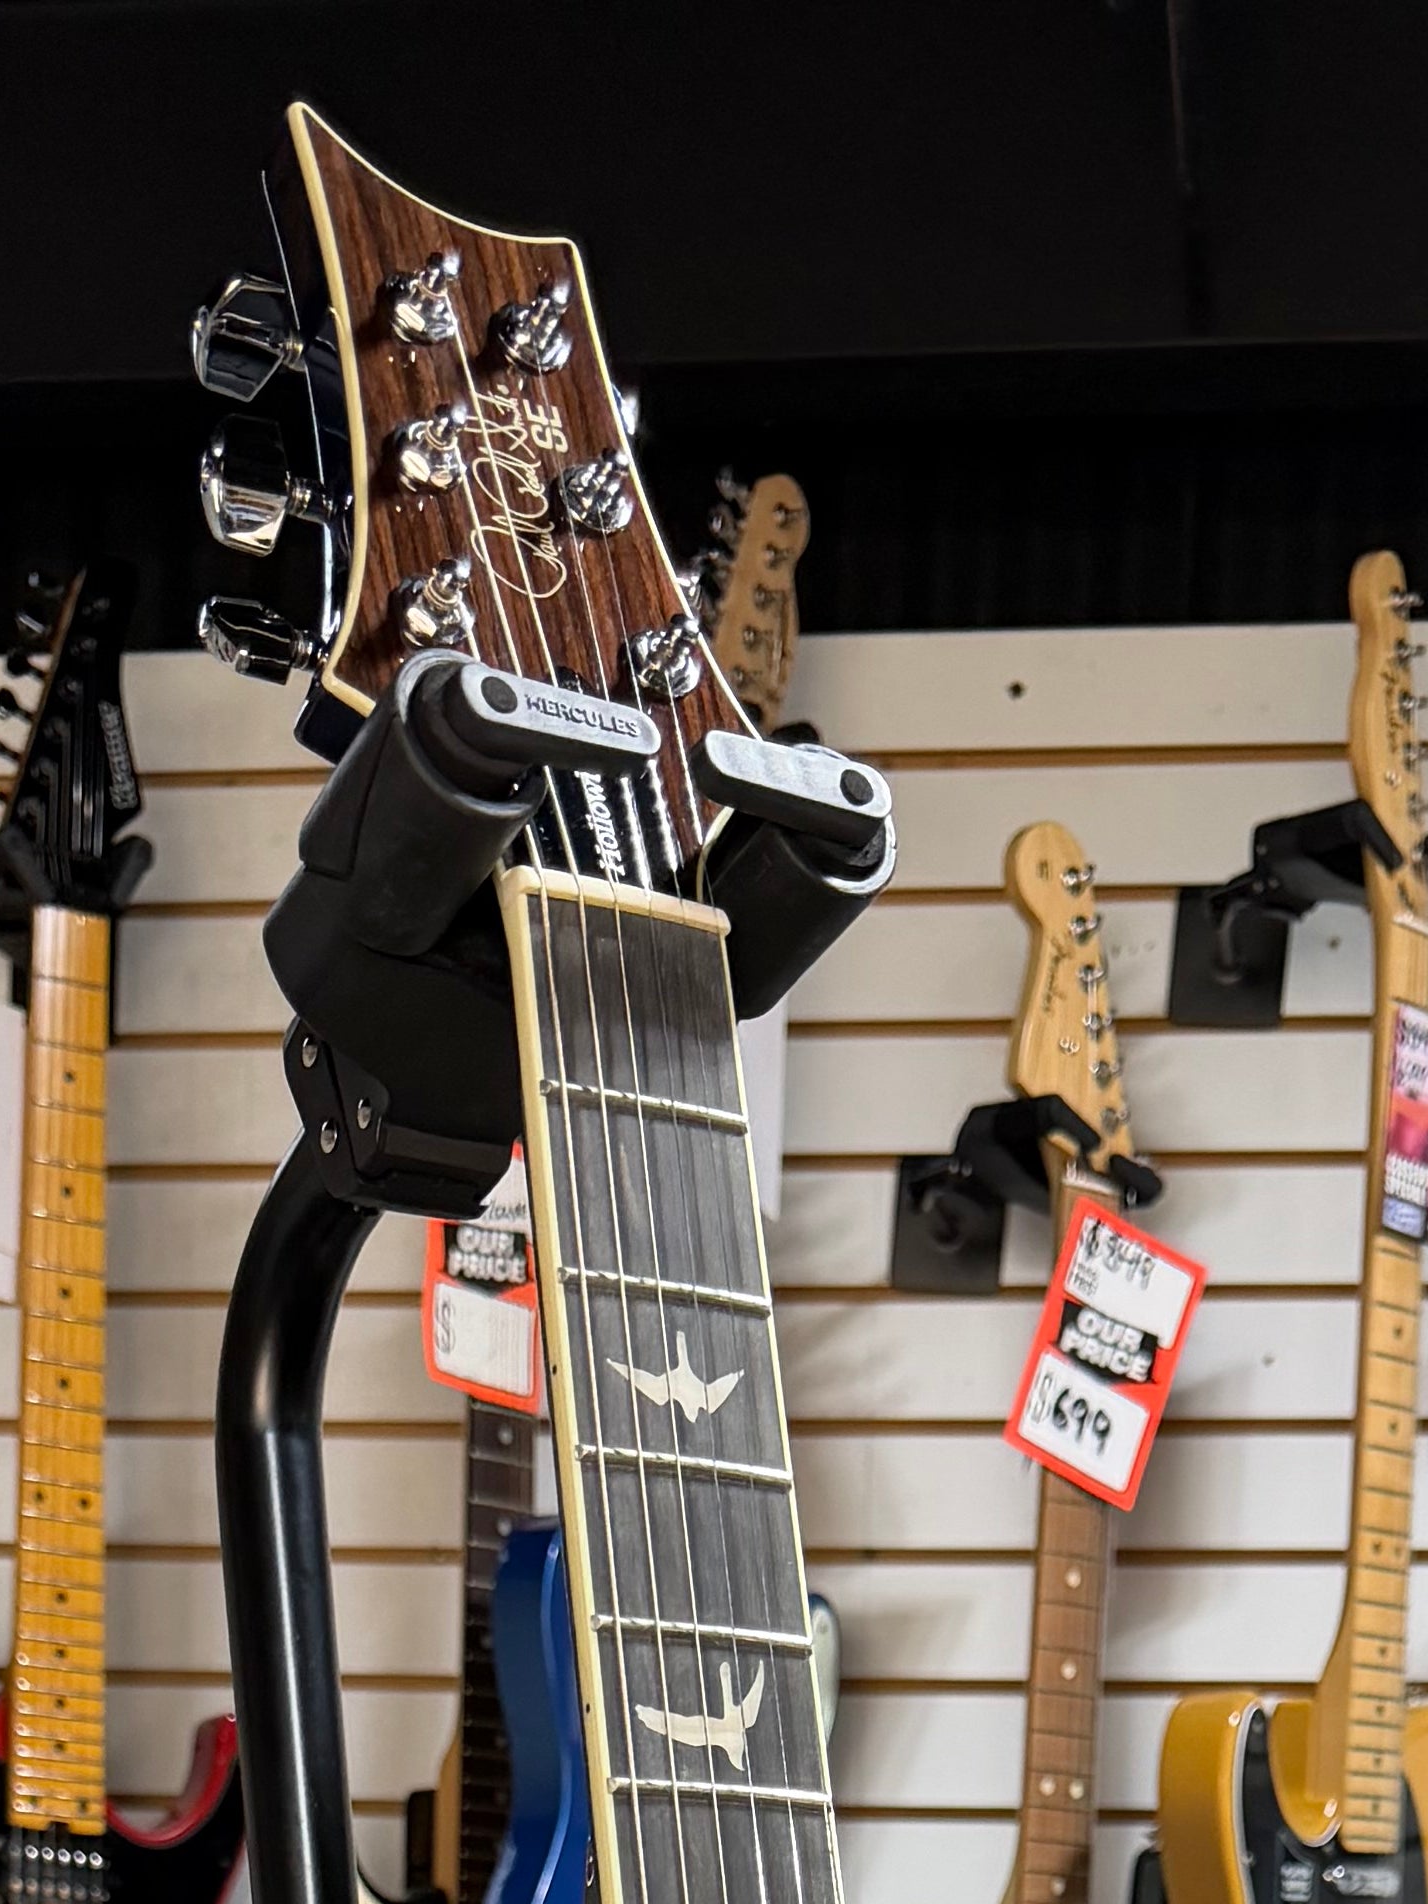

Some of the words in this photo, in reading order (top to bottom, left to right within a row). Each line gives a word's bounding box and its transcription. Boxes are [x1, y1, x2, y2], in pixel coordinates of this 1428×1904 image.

[522, 398, 570, 454] SE
[524, 693, 641, 738] HERCULES
[456, 1225, 515, 1257] OUR
[447, 1248, 528, 1285] PRICE
[1076, 1306, 1144, 1353] OUR
[1060, 1328, 1154, 1384] PRICE
